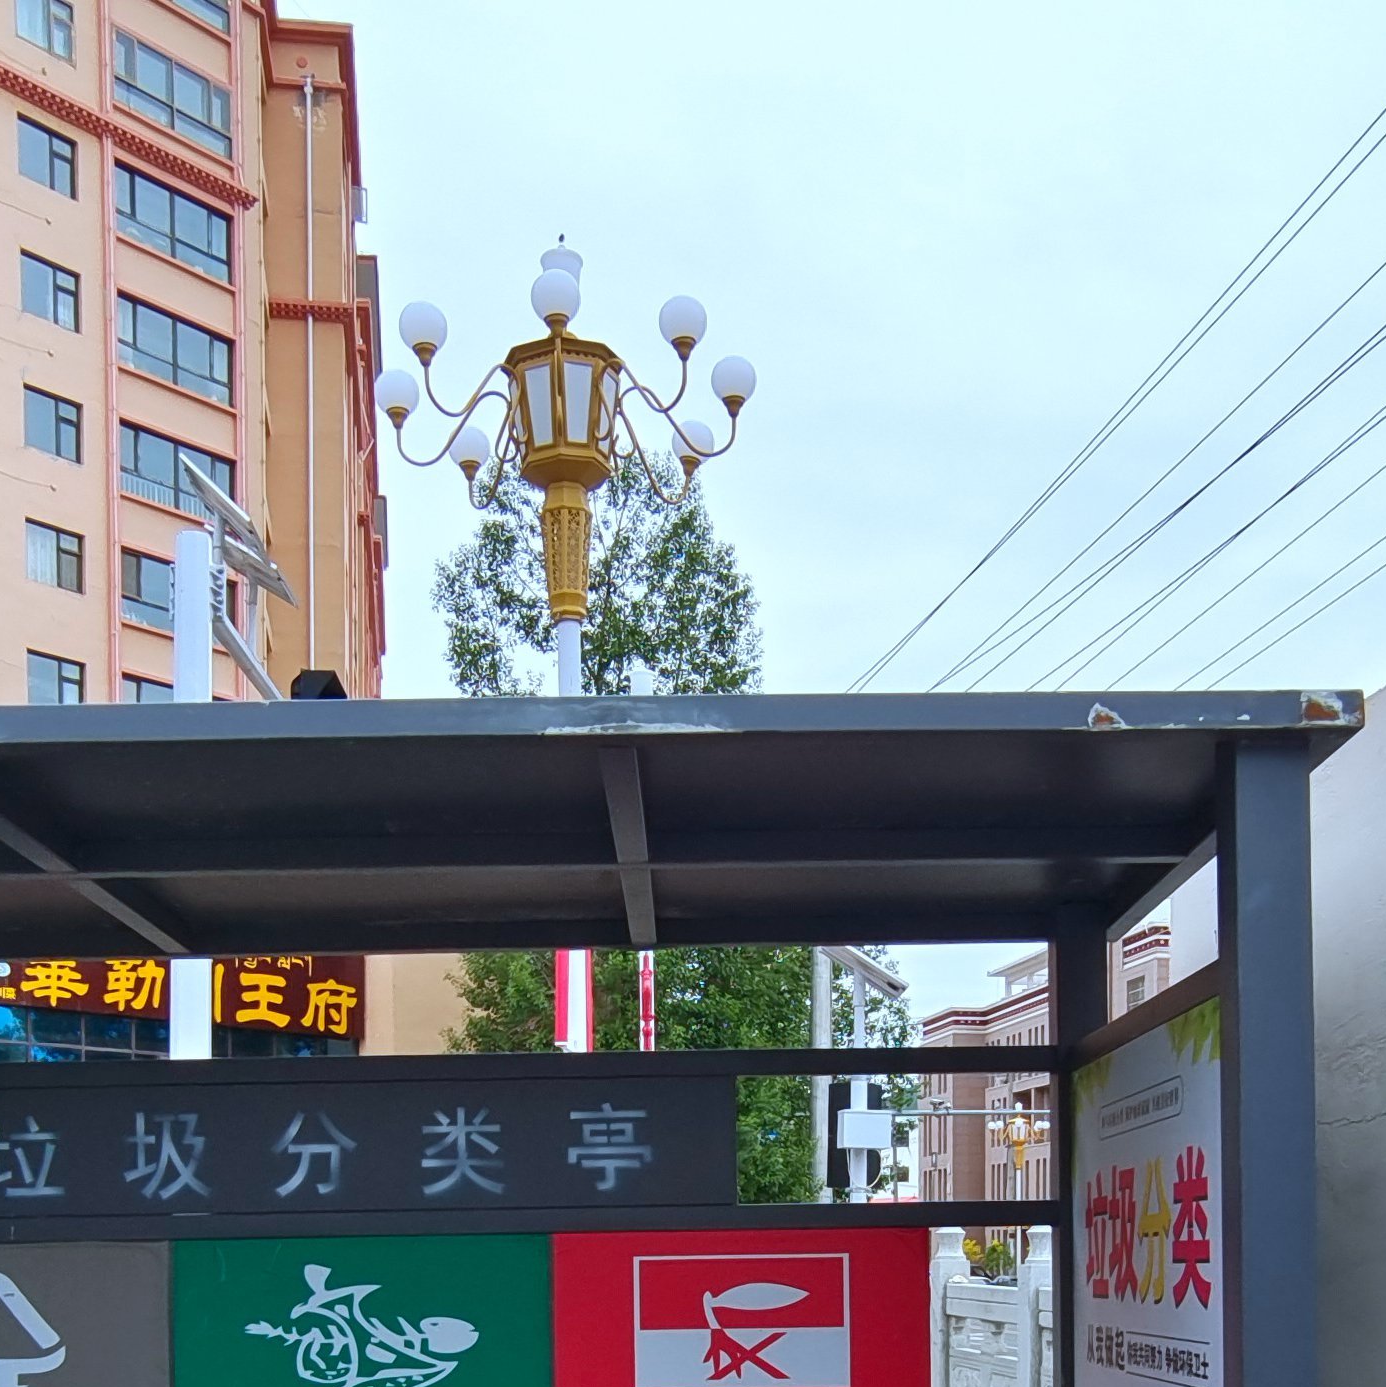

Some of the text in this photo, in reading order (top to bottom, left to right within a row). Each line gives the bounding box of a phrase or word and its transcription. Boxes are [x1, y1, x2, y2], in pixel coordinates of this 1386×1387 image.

[1084, 1145, 1212, 1311] 垃圾分类
[1087, 1324, 1125, 1371] 从我做起
